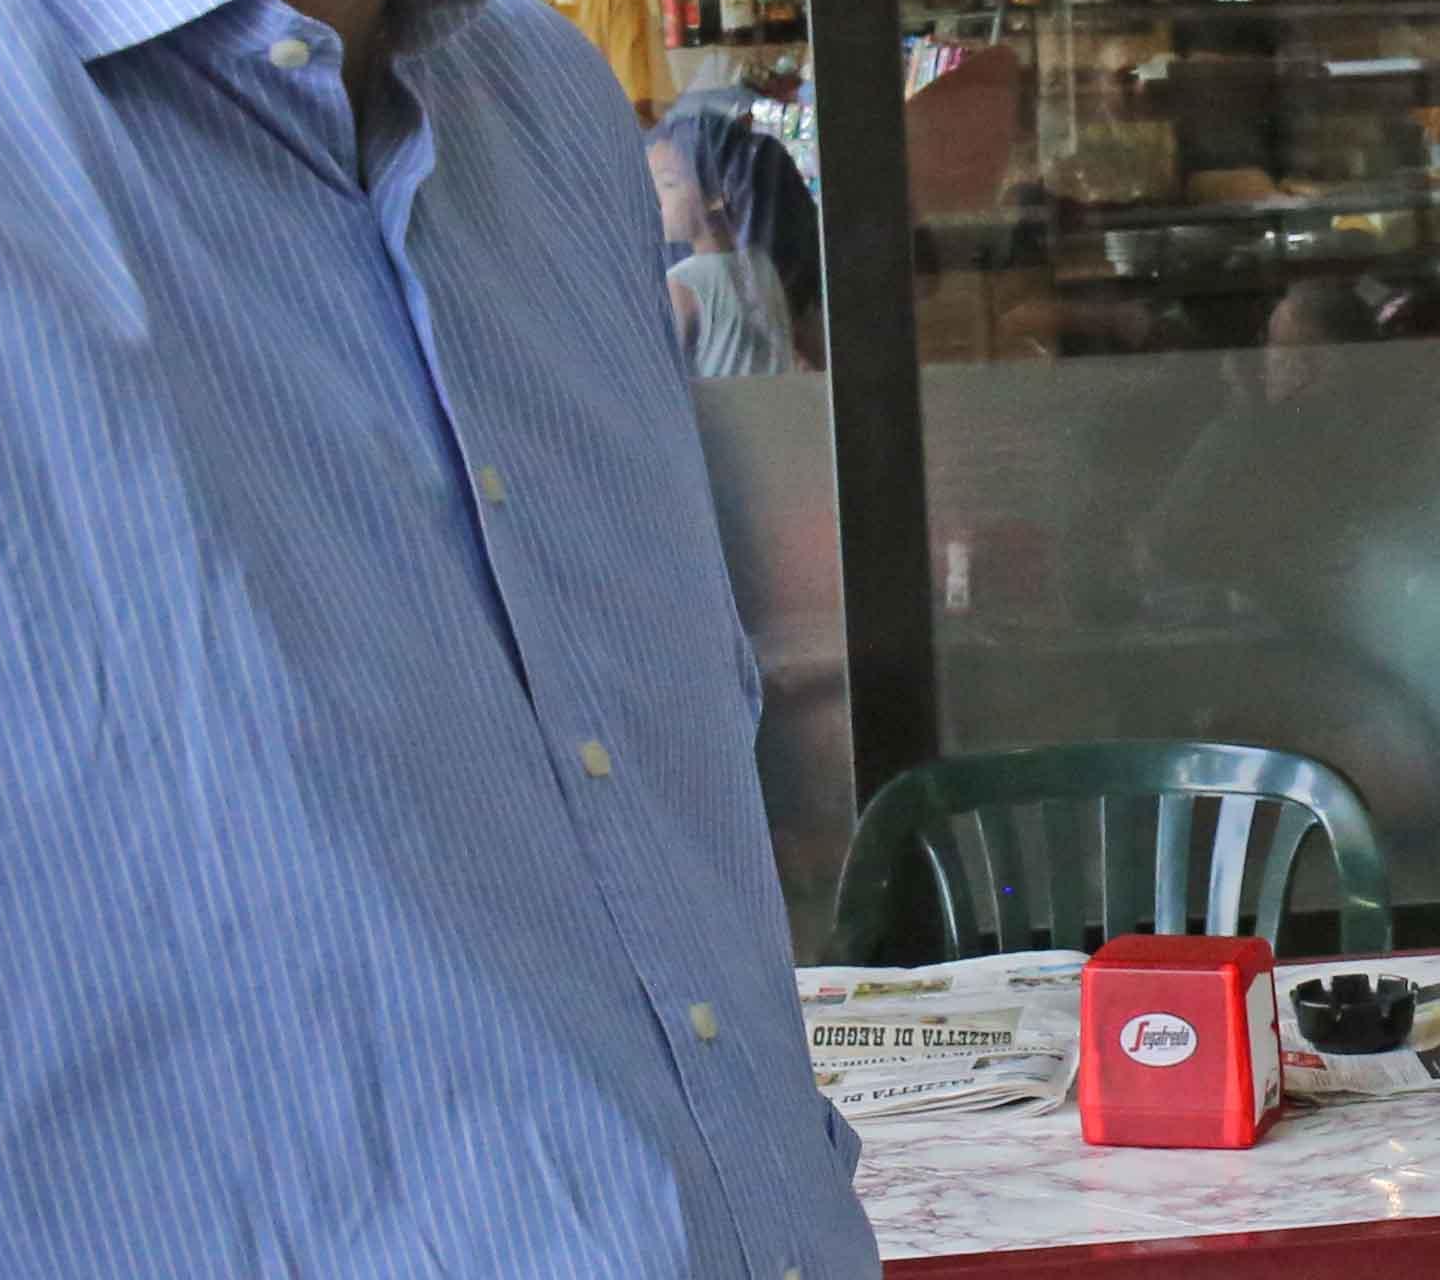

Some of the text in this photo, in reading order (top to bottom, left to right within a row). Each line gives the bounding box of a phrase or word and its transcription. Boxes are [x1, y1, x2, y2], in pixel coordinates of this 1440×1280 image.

[812, 1025, 1012, 1047] GAZZETTA DI REGGIO
[1129, 1020, 1190, 1053] Segafredo
